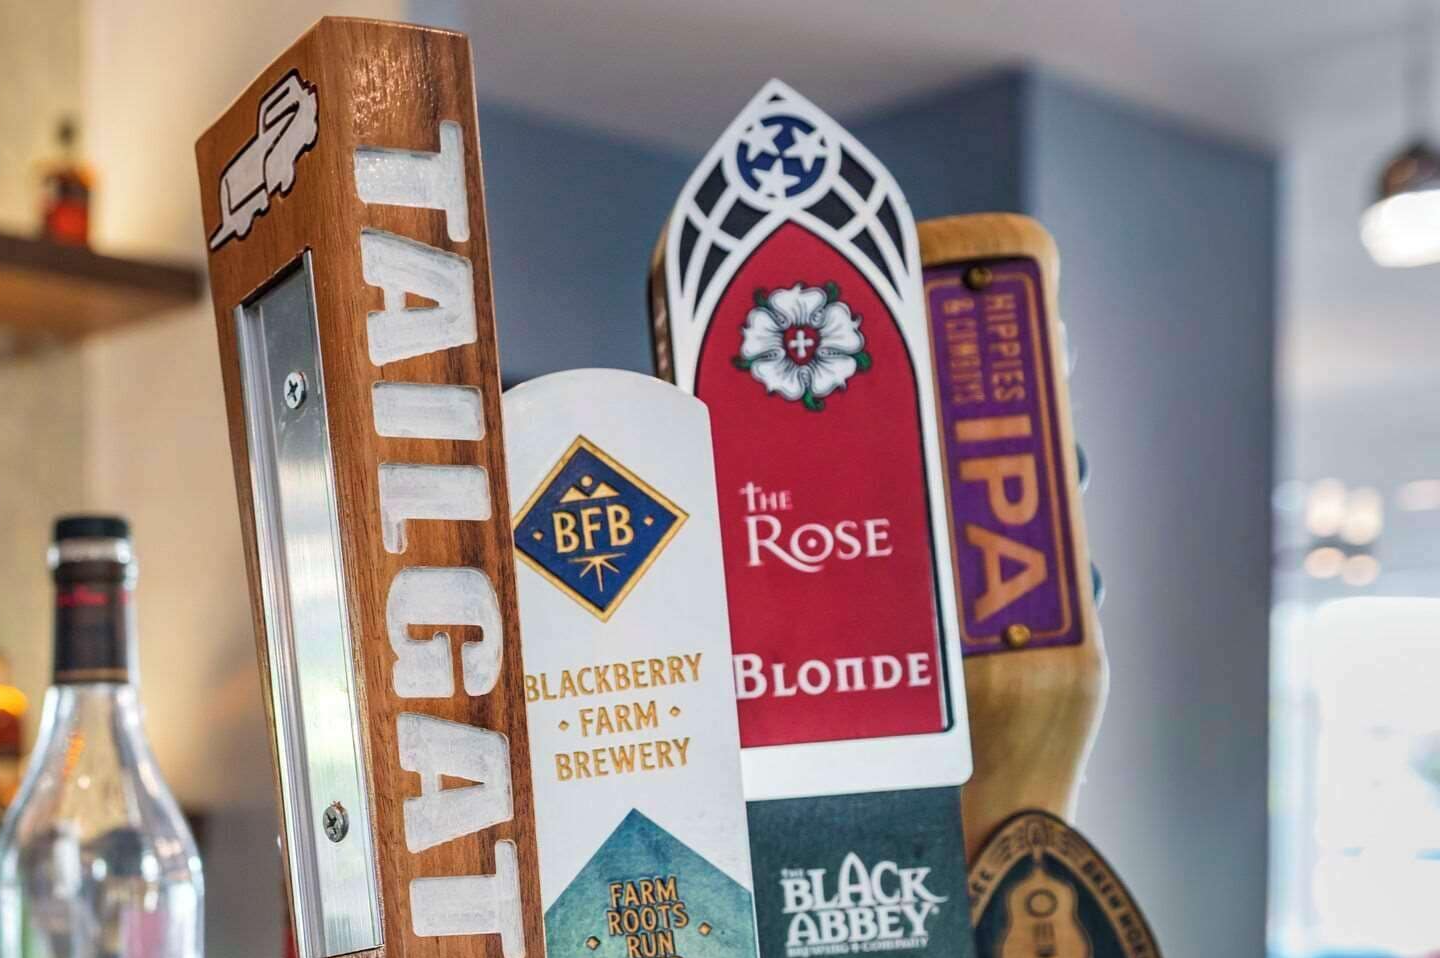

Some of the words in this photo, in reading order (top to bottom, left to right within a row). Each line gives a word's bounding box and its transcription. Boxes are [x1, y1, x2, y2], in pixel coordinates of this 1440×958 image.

[984, 293, 1026, 403] HIPPIES
[739, 481, 792, 513] THE
[955, 414, 1048, 622] IPA
[552, 503, 635, 553] BFB
[745, 514, 893, 573] ROSE
[525, 652, 703, 702] BLACKBERRY
[732, 651, 932, 700] BLONDE
[579, 700, 659, 737] FARM
[555, 736, 690, 781] BREWERY
[609, 875, 679, 908] FARM
[780, 851, 949, 914] BLACK
[607, 901, 689, 936] ROOTS
[785, 902, 936, 948] ABBEY
[625, 929, 676, 958] RUN
